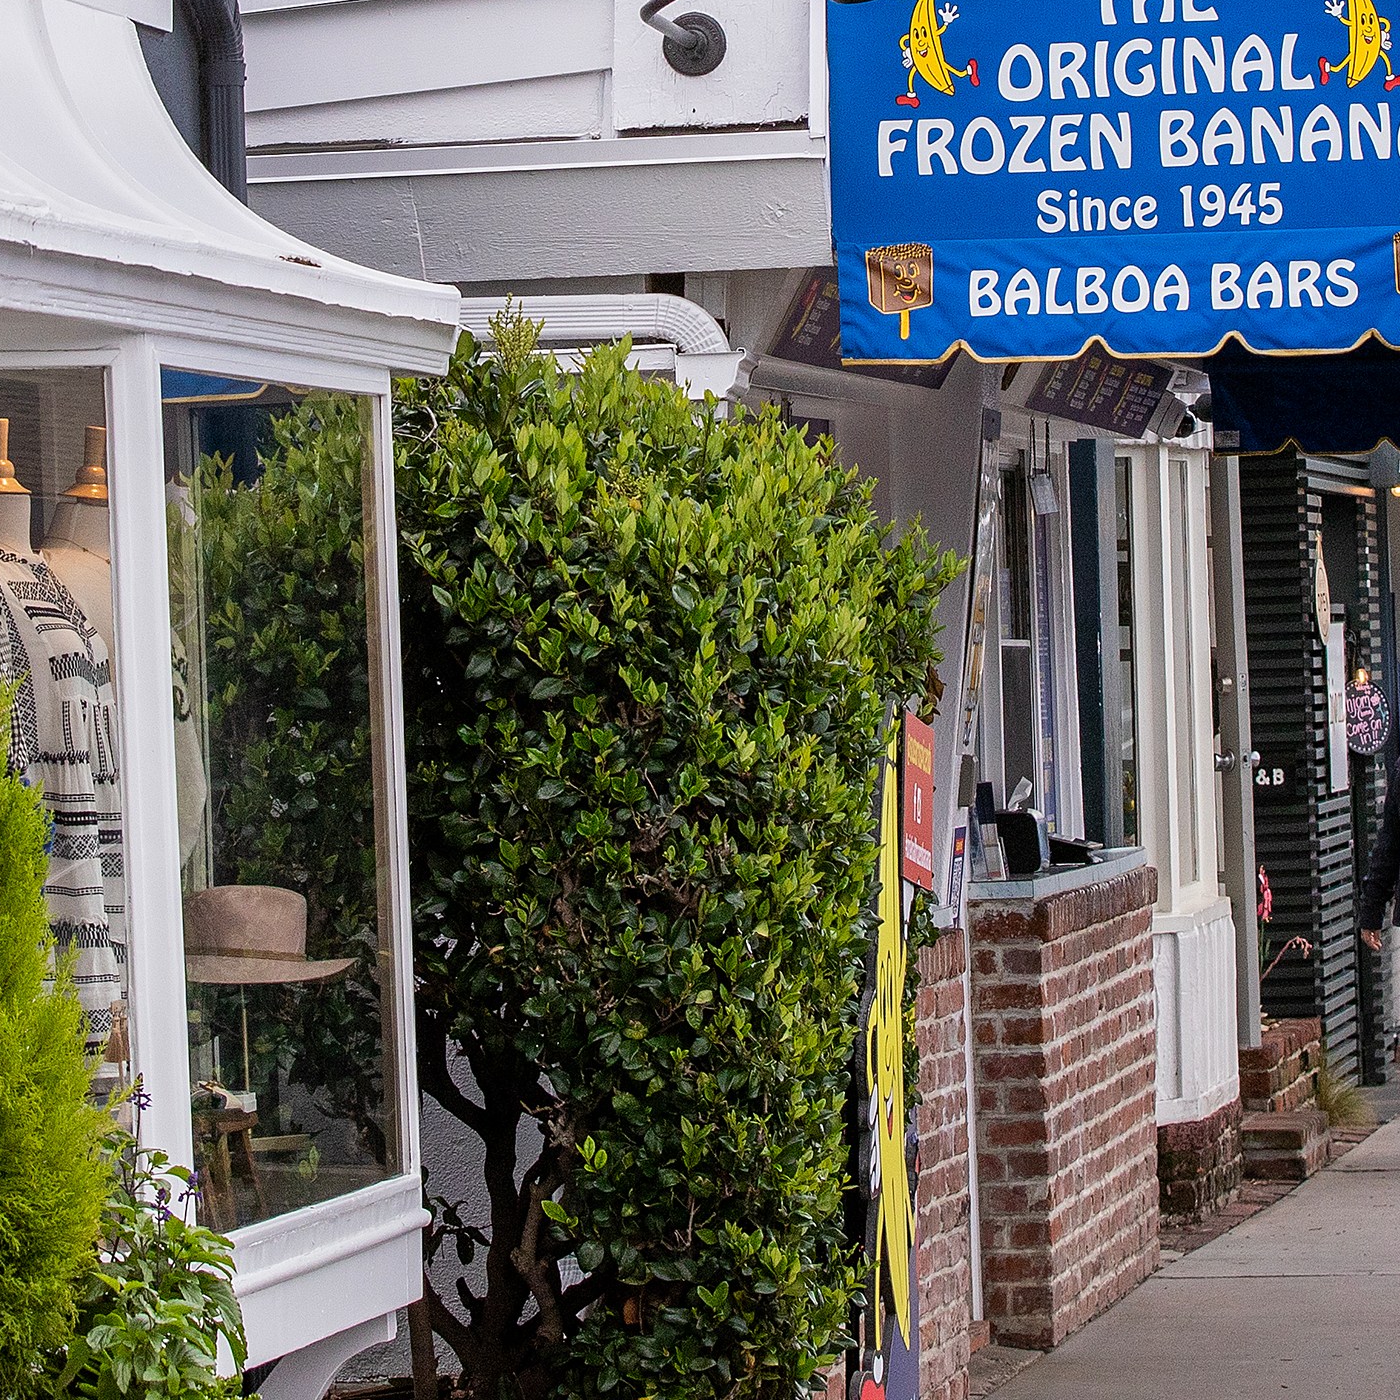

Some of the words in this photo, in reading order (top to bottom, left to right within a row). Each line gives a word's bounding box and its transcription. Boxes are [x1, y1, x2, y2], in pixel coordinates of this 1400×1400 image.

[997, 33, 1316, 102] ORIGINAL
[876, 113, 1133, 177] FROZEN
[1036, 187, 1158, 234] Since
[1180, 181, 1284, 228] 1945
[969, 264, 1189, 317] BALBOA
[1210, 258, 1359, 310] BARS
